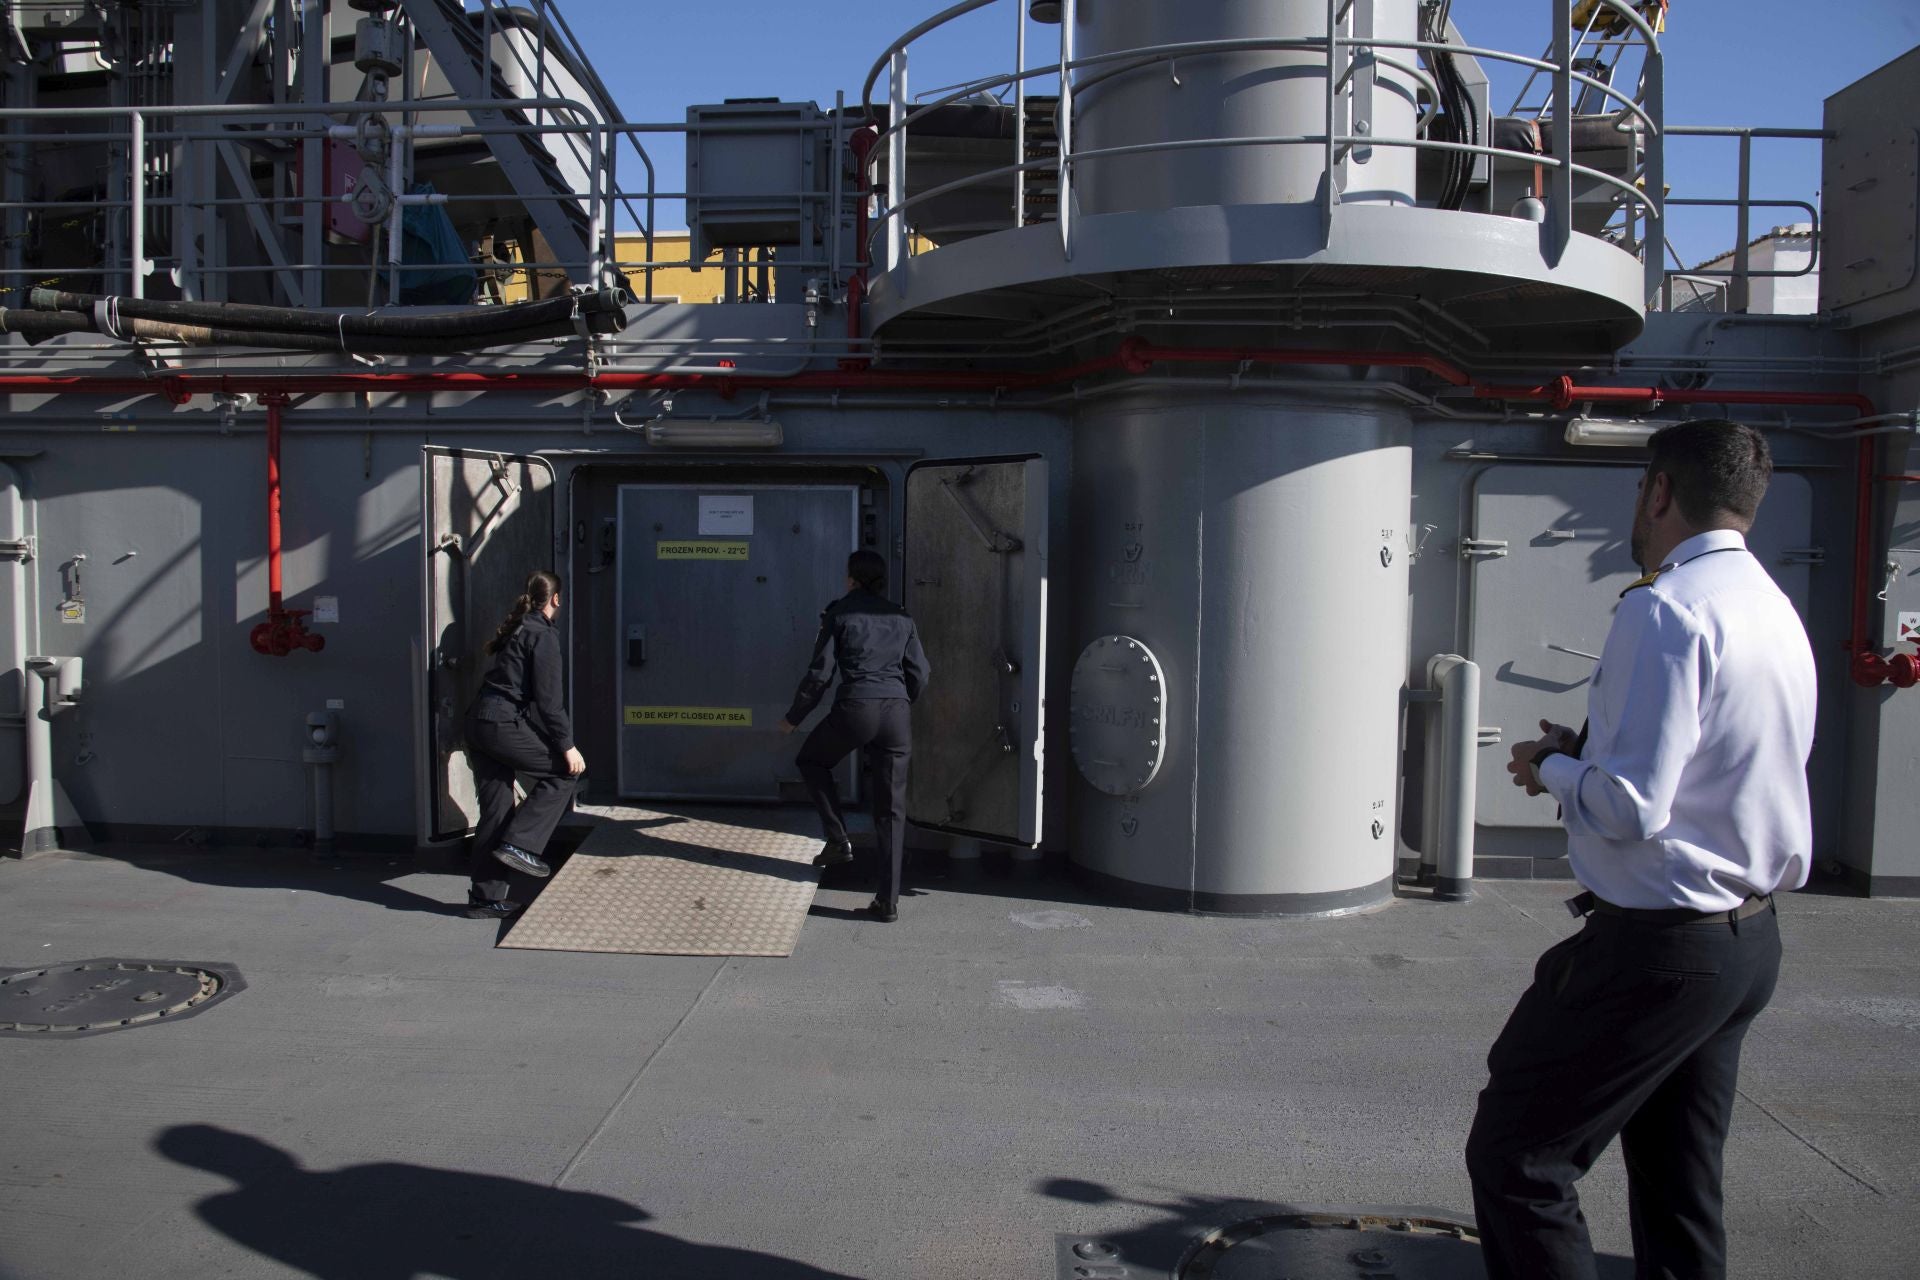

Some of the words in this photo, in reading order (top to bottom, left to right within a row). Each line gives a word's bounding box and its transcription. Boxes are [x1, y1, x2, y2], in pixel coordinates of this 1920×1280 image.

[660, 546, 694, 554] FROZEN
[695, 546, 720, 554] PROV.
[727, 547, 746, 555] 22°C
[631, 711, 643, 719] TO
[644, 711, 656, 719] BE
[657, 711, 679, 719] KEPT
[680, 712, 714, 720] CLOSED
[728, 713, 746, 721] SEA
